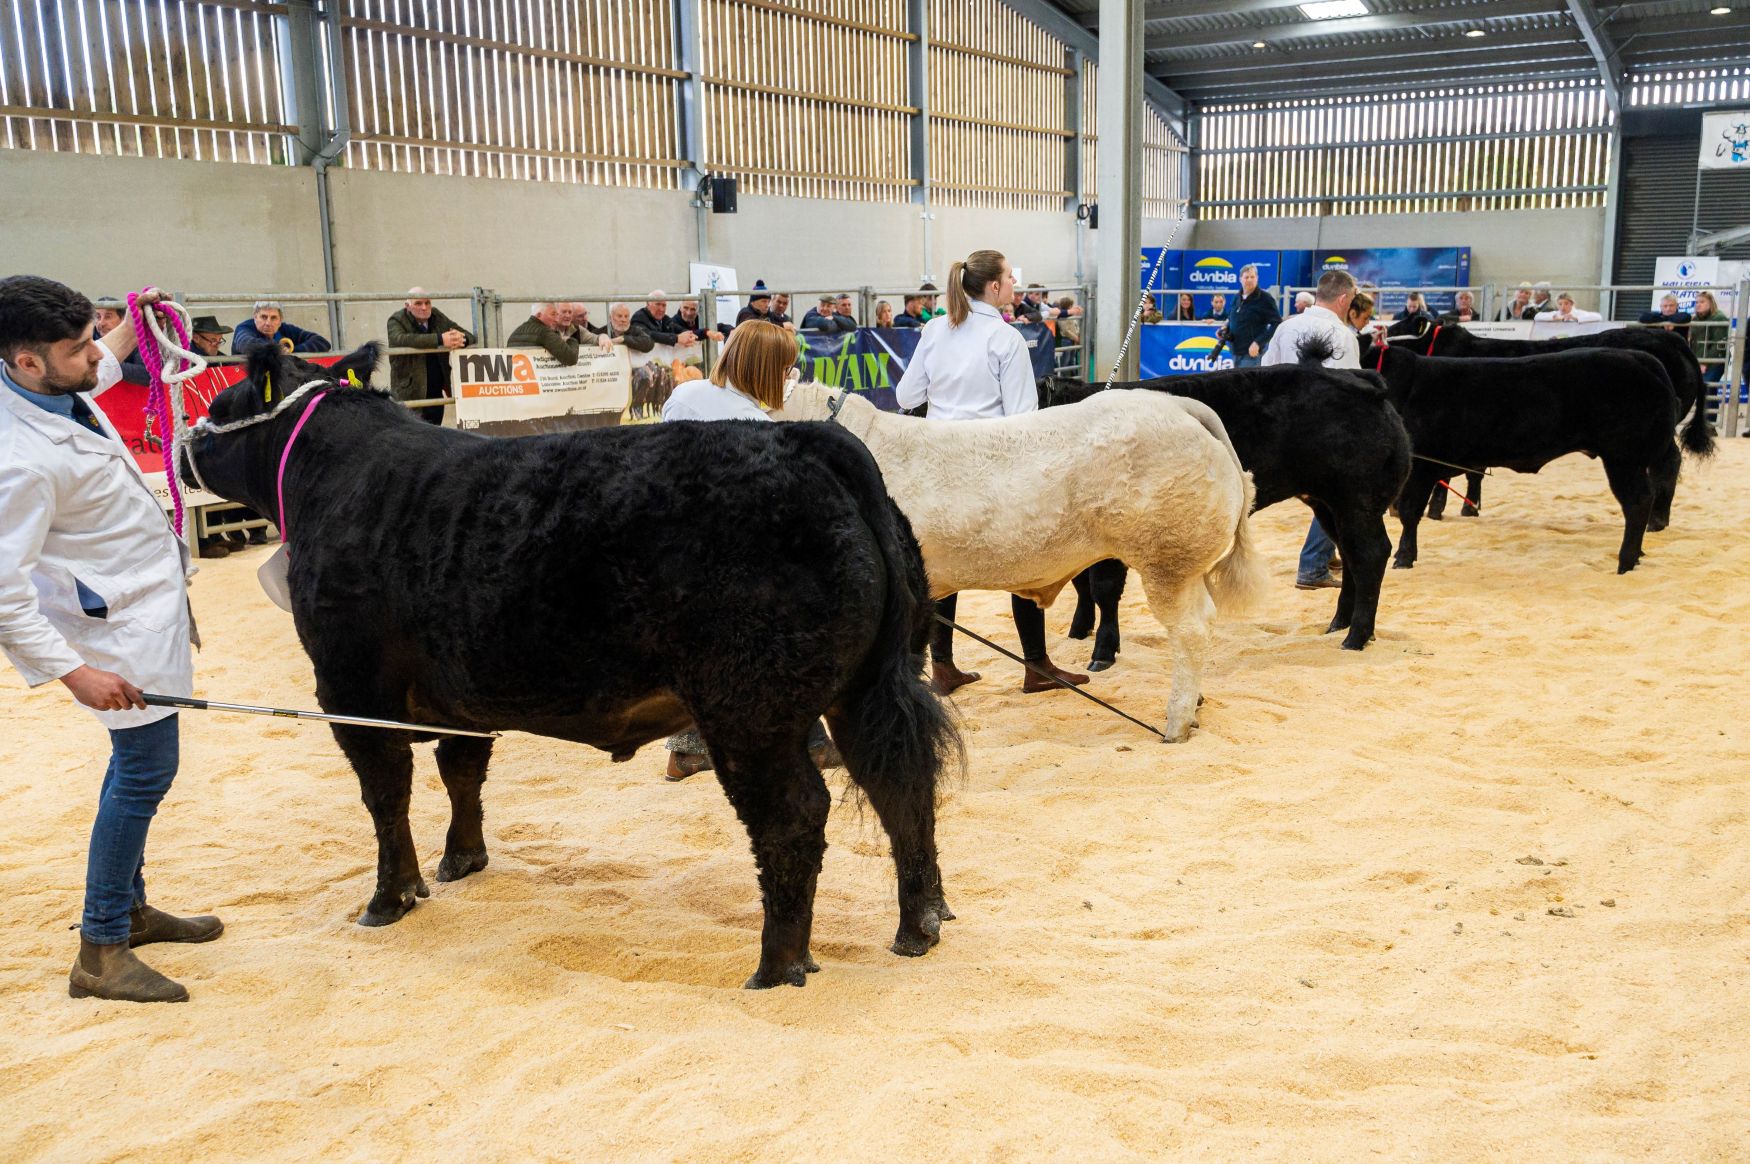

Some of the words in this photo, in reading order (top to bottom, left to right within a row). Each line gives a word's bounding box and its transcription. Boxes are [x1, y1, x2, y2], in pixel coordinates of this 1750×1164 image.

[1189, 270, 1237, 284] dunbia
[459, 353, 536, 383] nwa
[1168, 354, 1234, 372] dunbia
[479, 385, 524, 396] AUCTIONS
